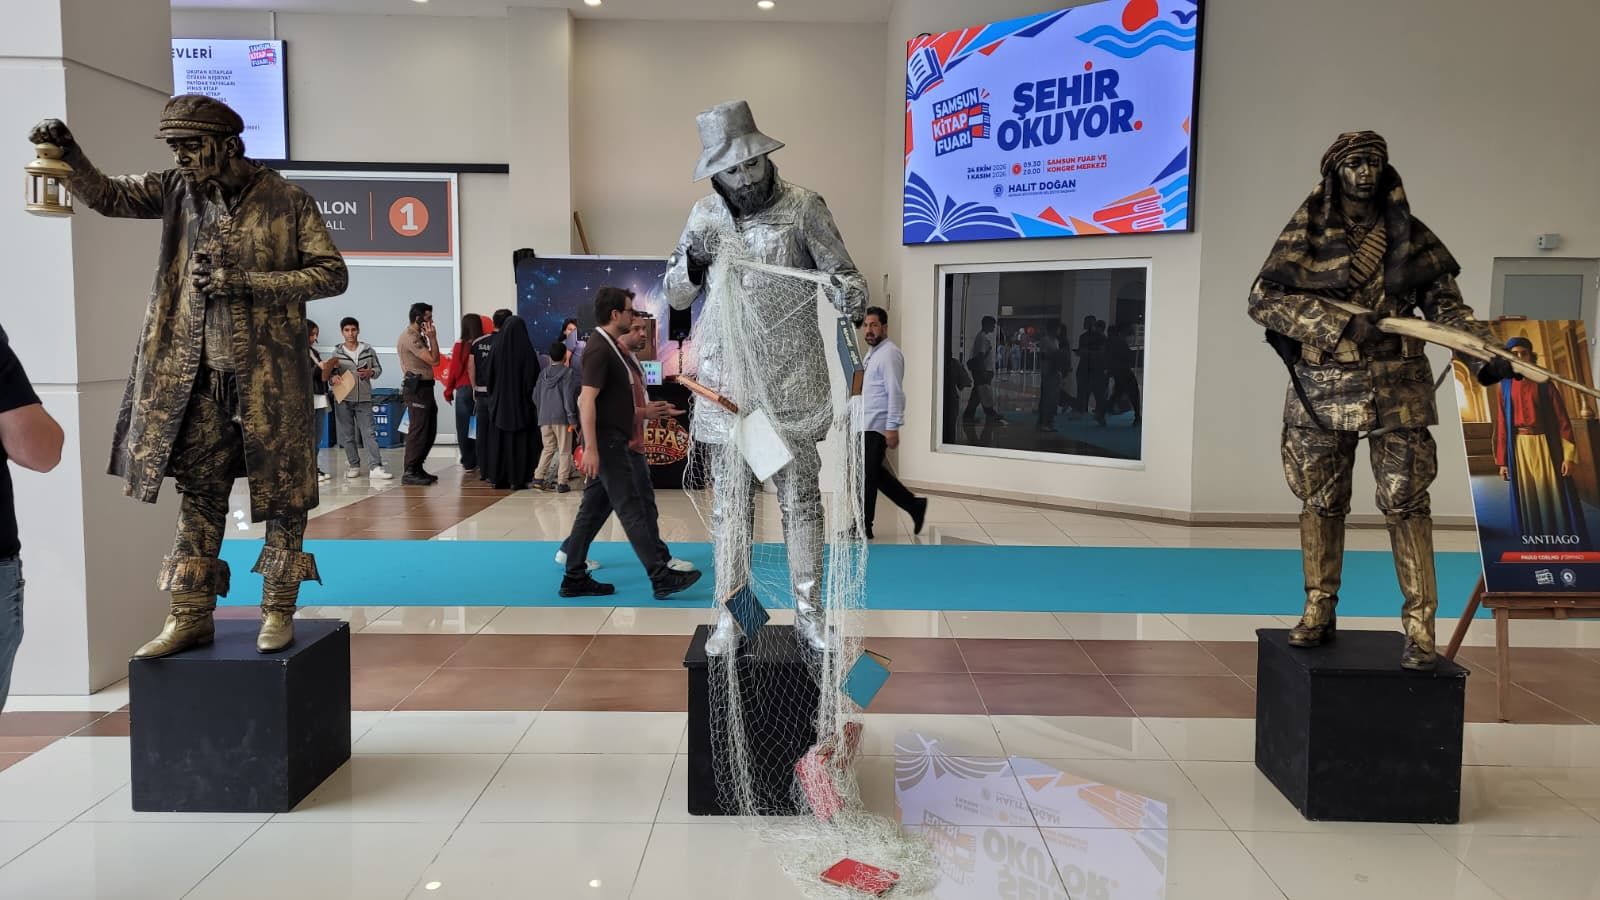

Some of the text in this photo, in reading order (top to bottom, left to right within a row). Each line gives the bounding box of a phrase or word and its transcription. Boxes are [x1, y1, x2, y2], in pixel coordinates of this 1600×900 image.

[1013, 61, 1119, 120] ŞEHİR
[934, 90, 978, 119] SAMSUN
[932, 112, 968, 139] KİTAP
[997, 99, 1143, 151] OKUYOR.
[936, 131, 972, 155] FUARI
[1023, 160, 1041, 168] 09.30
[1047, 157, 1076, 166] SAMSUN
[1077, 155, 1096, 163] FUAR
[1047, 162, 1107, 173] KONGRE MERKEZİ
[976, 164, 992, 173] EKİM
[1023, 168, 1041, 176] 20.00
[1008, 182, 1037, 193] HALİT
[1039, 179, 1077, 191] DOĞAN
[400, 203, 419, 231] 1
[1522, 534, 1580, 545] SANTIAGO
